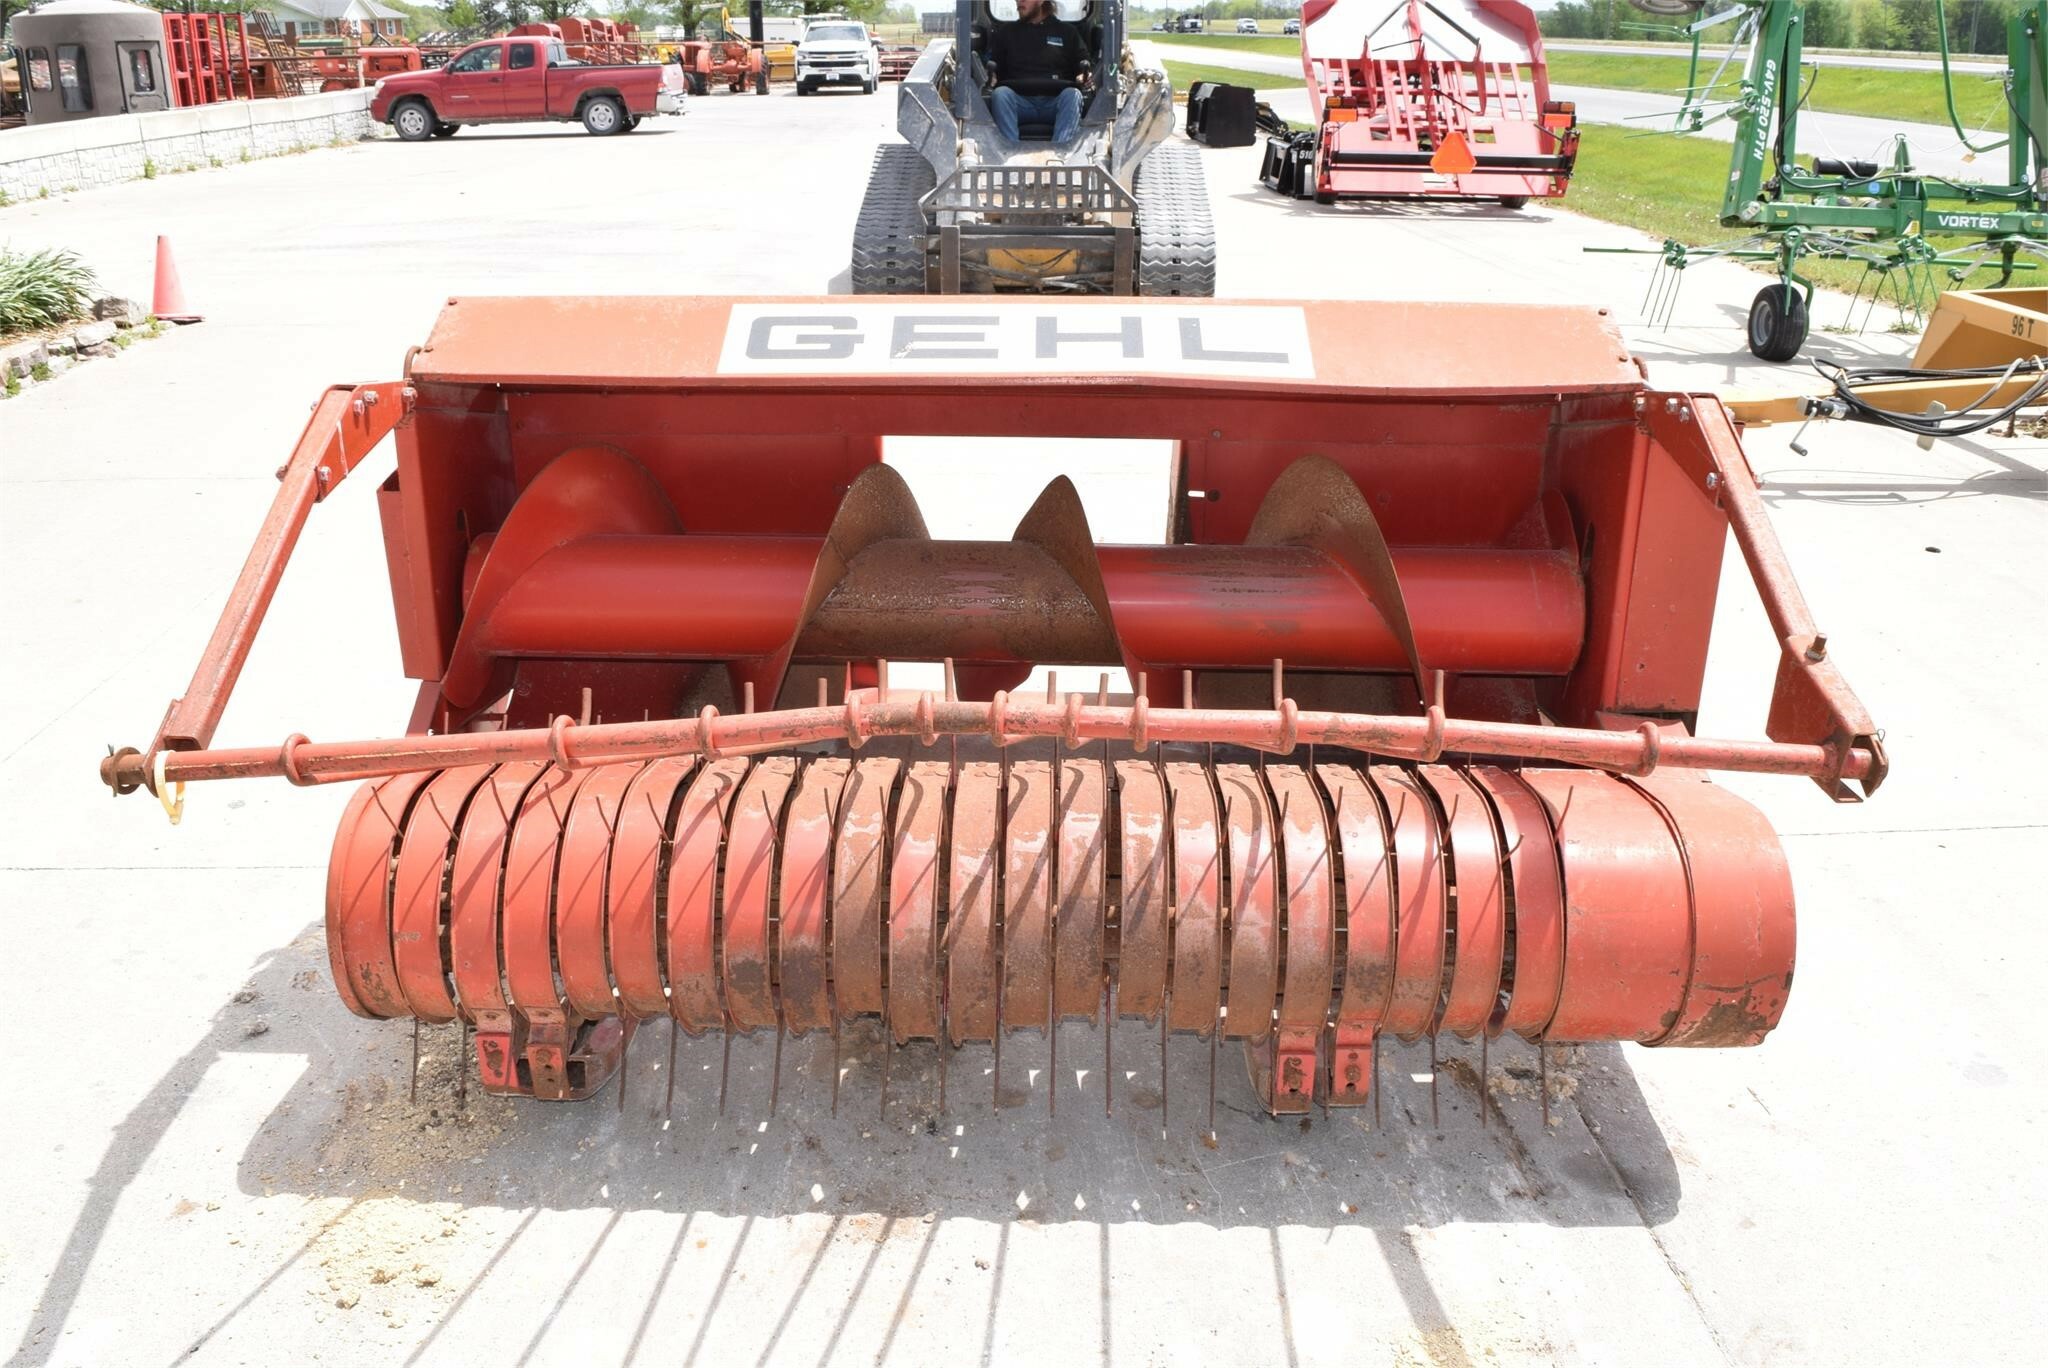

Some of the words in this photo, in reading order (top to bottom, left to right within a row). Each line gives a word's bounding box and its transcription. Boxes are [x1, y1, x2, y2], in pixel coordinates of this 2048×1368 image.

[1753, 128, 1766, 160] PTH
[1938, 215, 1999, 229] VORTEX
[2011, 315, 2024, 336] 96
[745, 316, 1289, 364] GEHL
